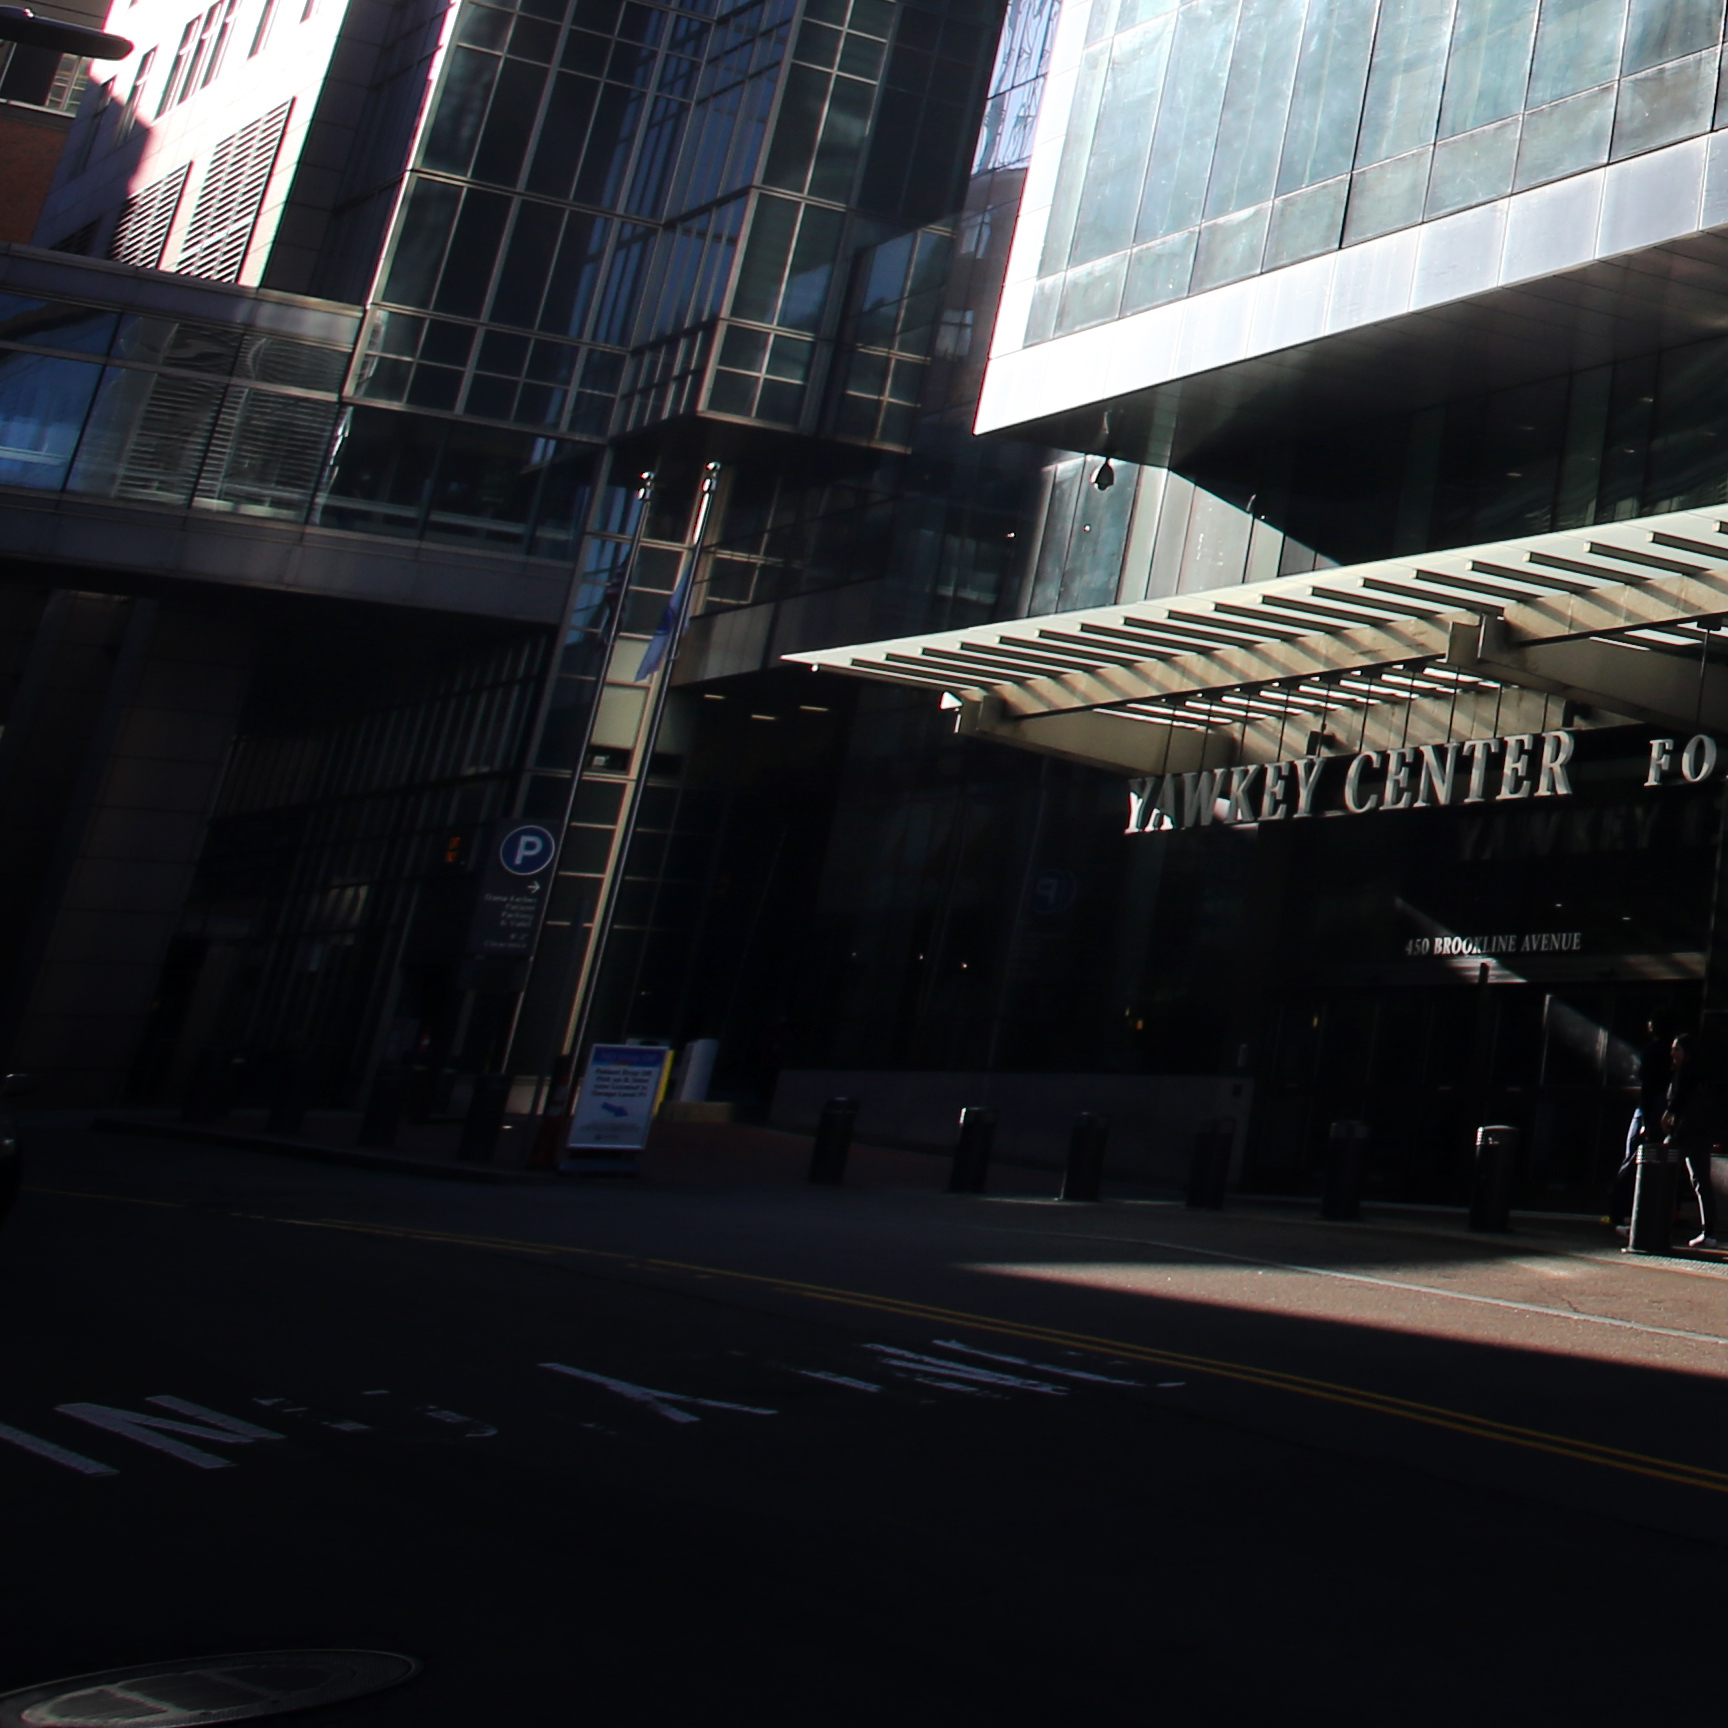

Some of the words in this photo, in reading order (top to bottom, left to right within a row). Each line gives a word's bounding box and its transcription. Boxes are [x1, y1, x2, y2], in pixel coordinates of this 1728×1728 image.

[1124, 757, 1325, 834] YAWKEY
[1343, 730, 1575, 815] CENTER
[1405, 937, 1431, 956] 450
[1434, 934, 1517, 955] BROOKLINE
[1520, 932, 1582, 953] AVENUE
